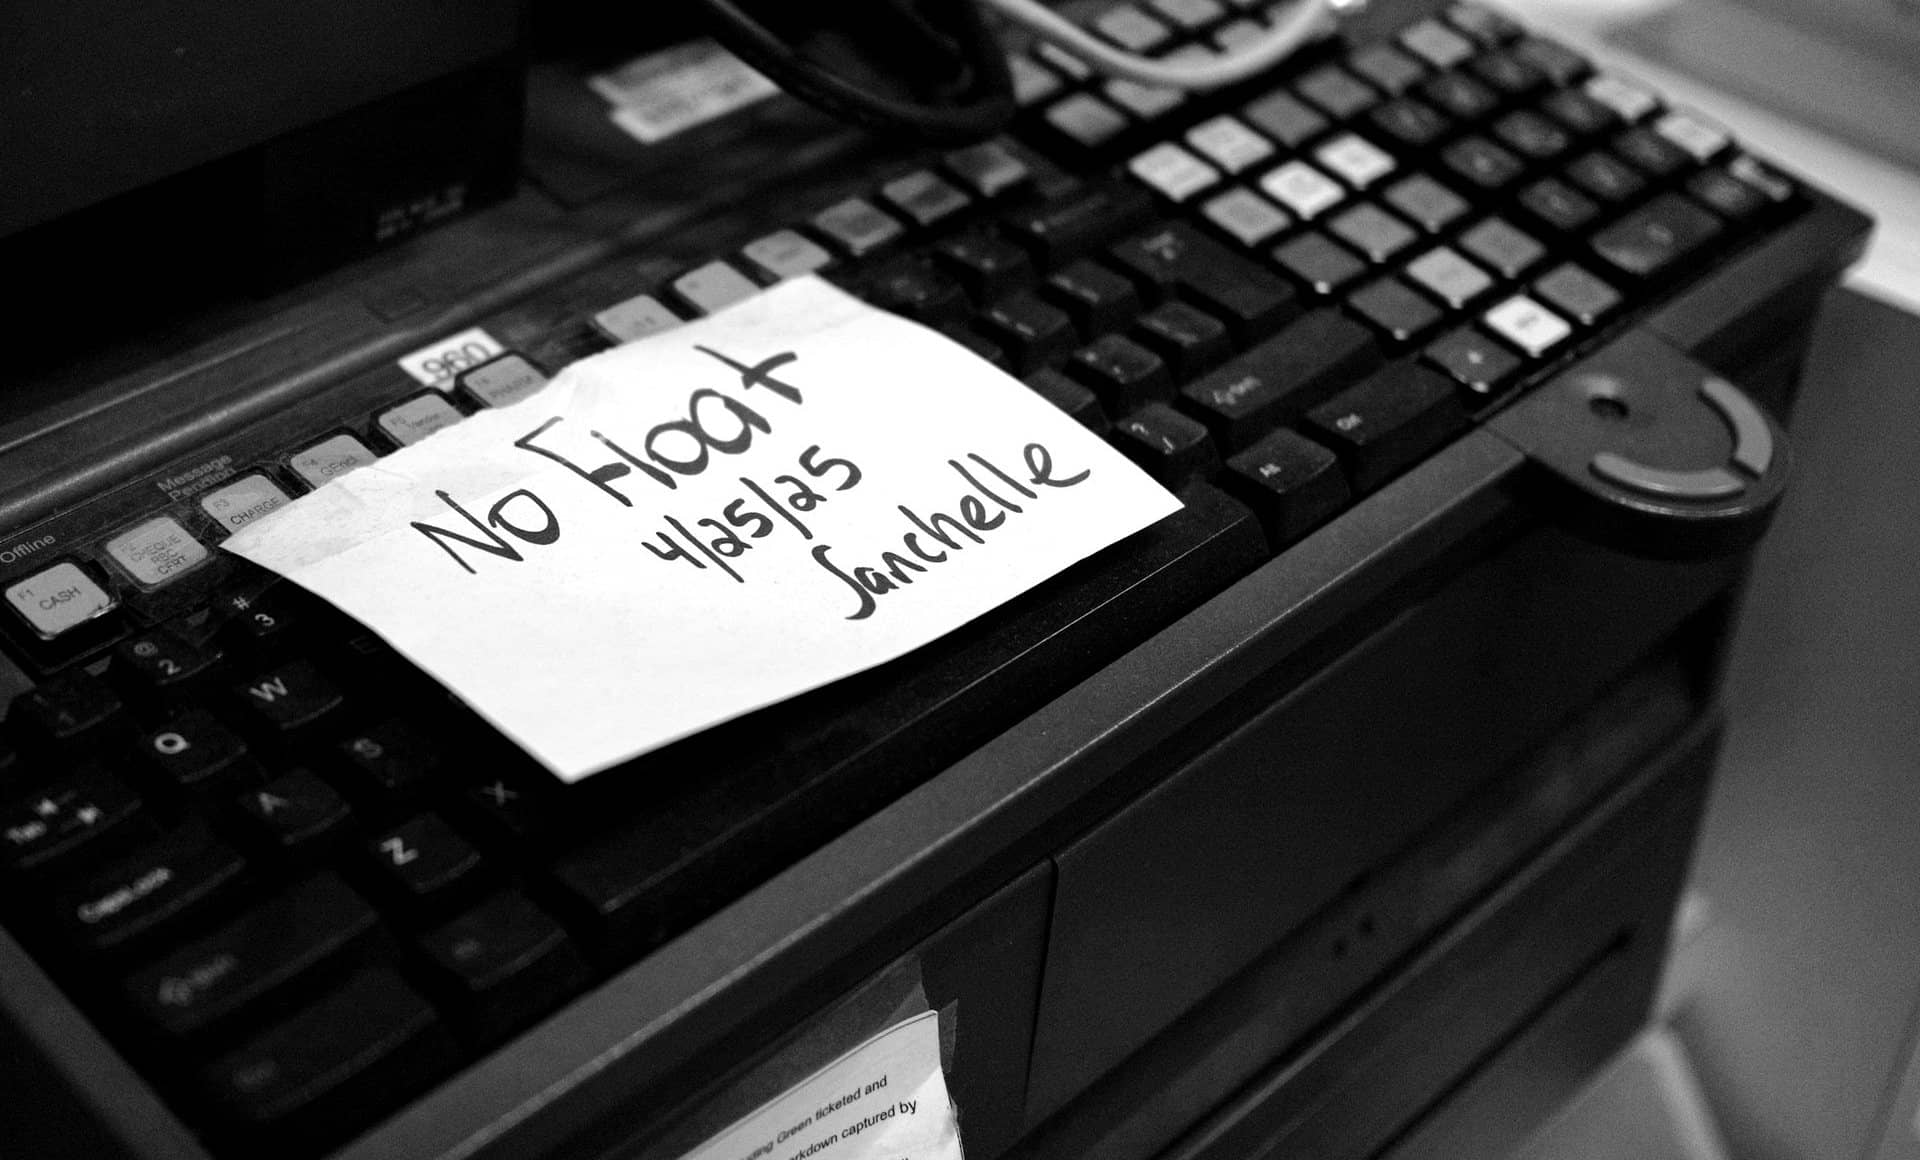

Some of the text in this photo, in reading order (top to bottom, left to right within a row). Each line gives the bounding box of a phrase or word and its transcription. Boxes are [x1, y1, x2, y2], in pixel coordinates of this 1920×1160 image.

[423, 343, 491, 381] 960
[515, 345, 802, 506] Float
[157, 455, 232, 493] Message
[230, 497, 282, 525] CHARGE
[642, 445, 862, 583] 4/25/25
[0, 535, 56, 563] Offline
[131, 534, 182, 562] CHEQUE
[39, 586, 82, 610] CASH
[254, 612, 276, 627] 3
[157, 658, 182, 676] 2
[249, 676, 289, 702] W
[378, 835, 420, 867] Z
[777, 1117, 813, 1144] Green
[815, 1089, 862, 1120] ticketed
[864, 1074, 889, 1096] and
[841, 1107, 896, 1139] captured
[899, 1099, 918, 1119] by
